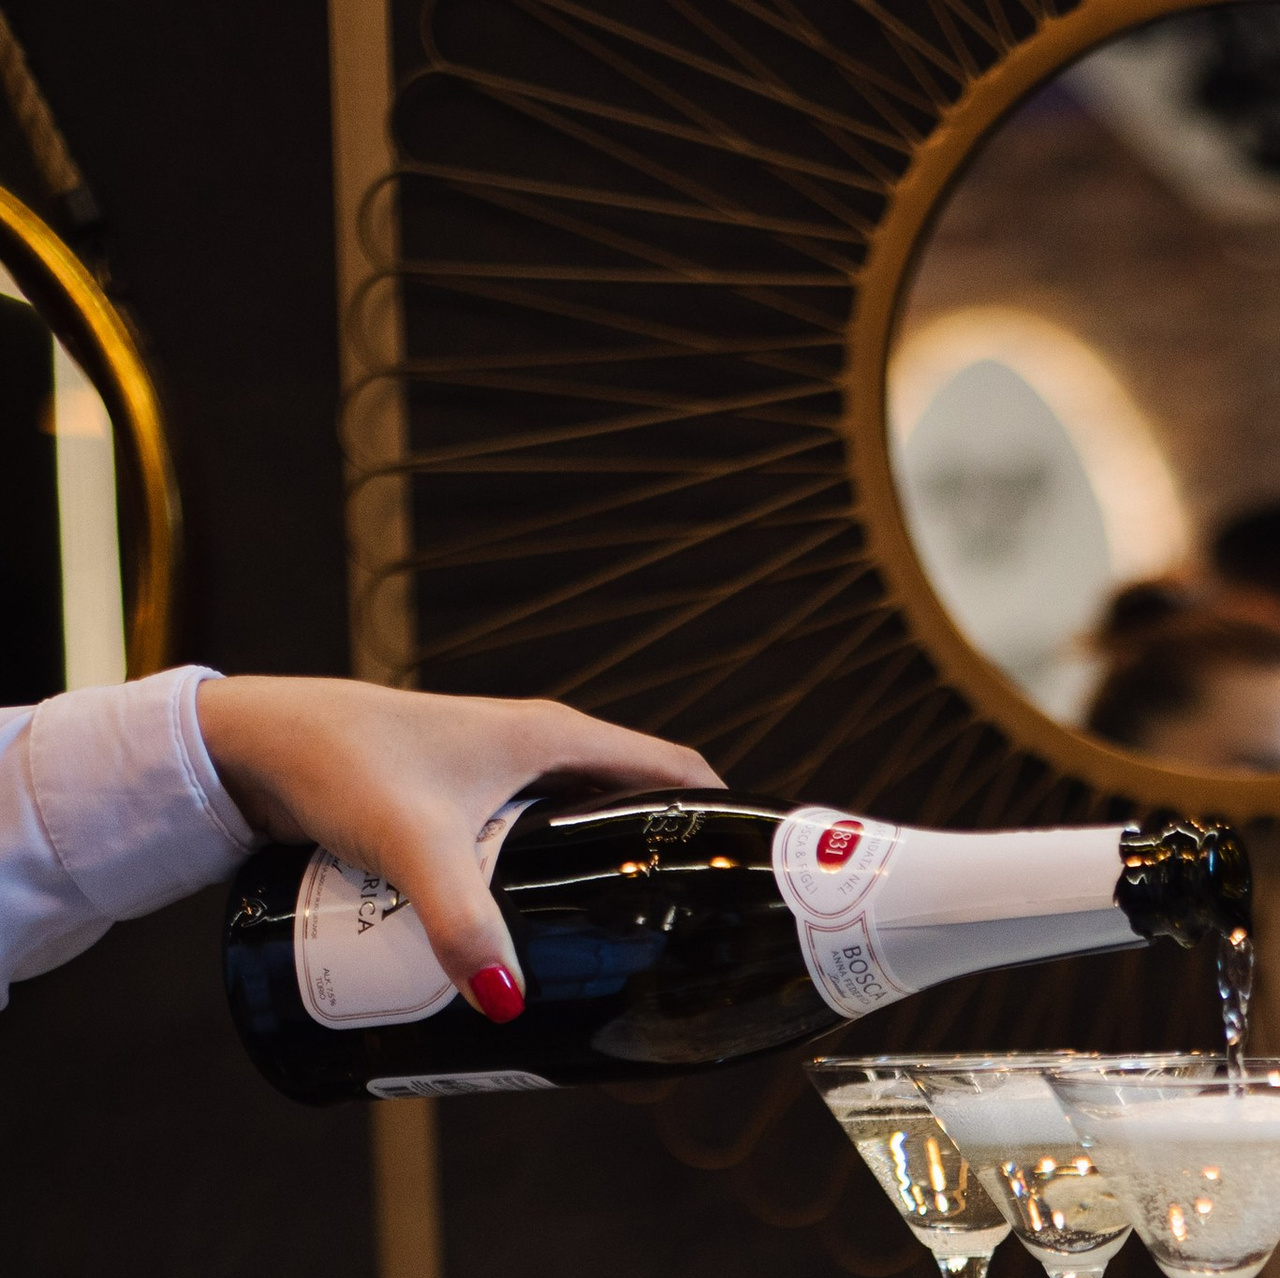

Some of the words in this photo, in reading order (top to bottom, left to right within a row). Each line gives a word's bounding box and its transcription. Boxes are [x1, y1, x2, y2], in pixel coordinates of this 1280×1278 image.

[825, 829, 852, 856] 831
[858, 824, 884, 870] NDATA
[799, 863, 818, 895] FIGLI
[837, 875, 860, 896] NEL
[358, 873, 380, 935] RICA
[831, 950, 847, 977] ANNA
[842, 945, 888, 1001] BOSCA
